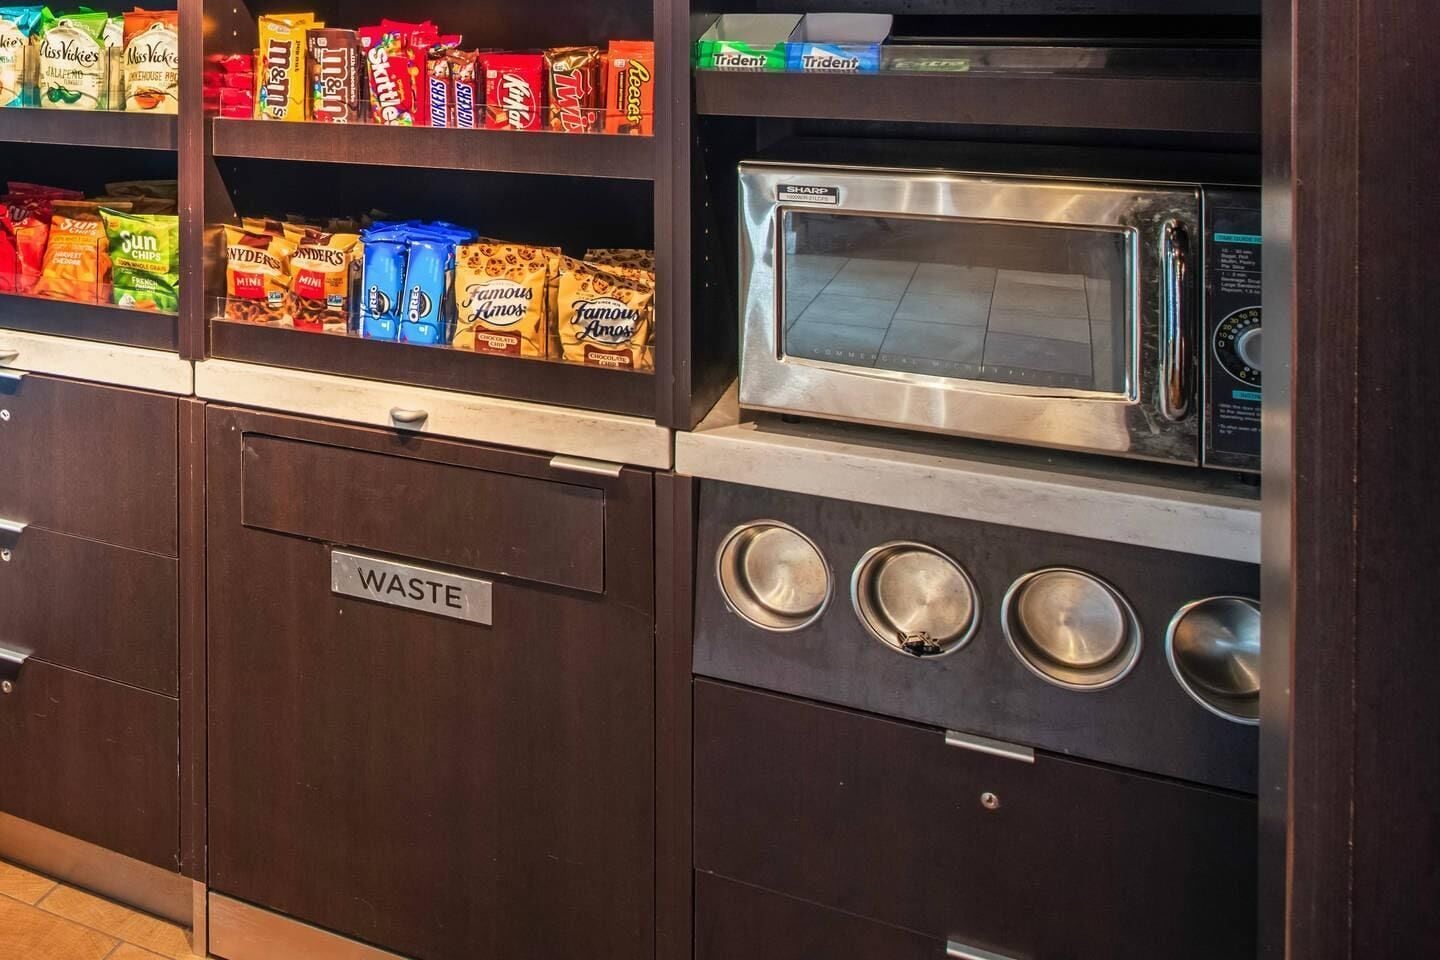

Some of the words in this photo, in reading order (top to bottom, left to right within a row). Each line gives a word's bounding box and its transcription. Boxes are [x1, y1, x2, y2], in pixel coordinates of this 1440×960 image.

[60, 39, 99, 68] Vickie's
[127, 47, 146, 65] Miss
[713, 53, 767, 67] Trident
[802, 54, 859, 69] Trident
[368, 47, 399, 126] Skittle
[626, 59, 650, 126] Reese's
[786, 186, 828, 194] SHARP
[60, 219, 98, 230] Sun
[120, 230, 157, 253] Sun
[132, 250, 161, 262] CHIPS
[131, 261, 149, 269] WHOLE
[131, 276, 158, 287] FRENCH
[236, 277, 263, 287] MINI
[298, 275, 322, 289] MINI
[368, 283, 380, 320] OREO
[462, 283, 533, 308] Famous
[409, 285, 421, 324] OREO
[468, 303, 526, 322] Amos
[570, 298, 640, 325] Famous
[575, 320, 632, 340] Amos
[478, 333, 516, 344] CHOCOLATE
[490, 341, 505, 349] CHIP
[589, 352, 628, 363] CHOCOLATE
[358, 567, 462, 609] WASTE
